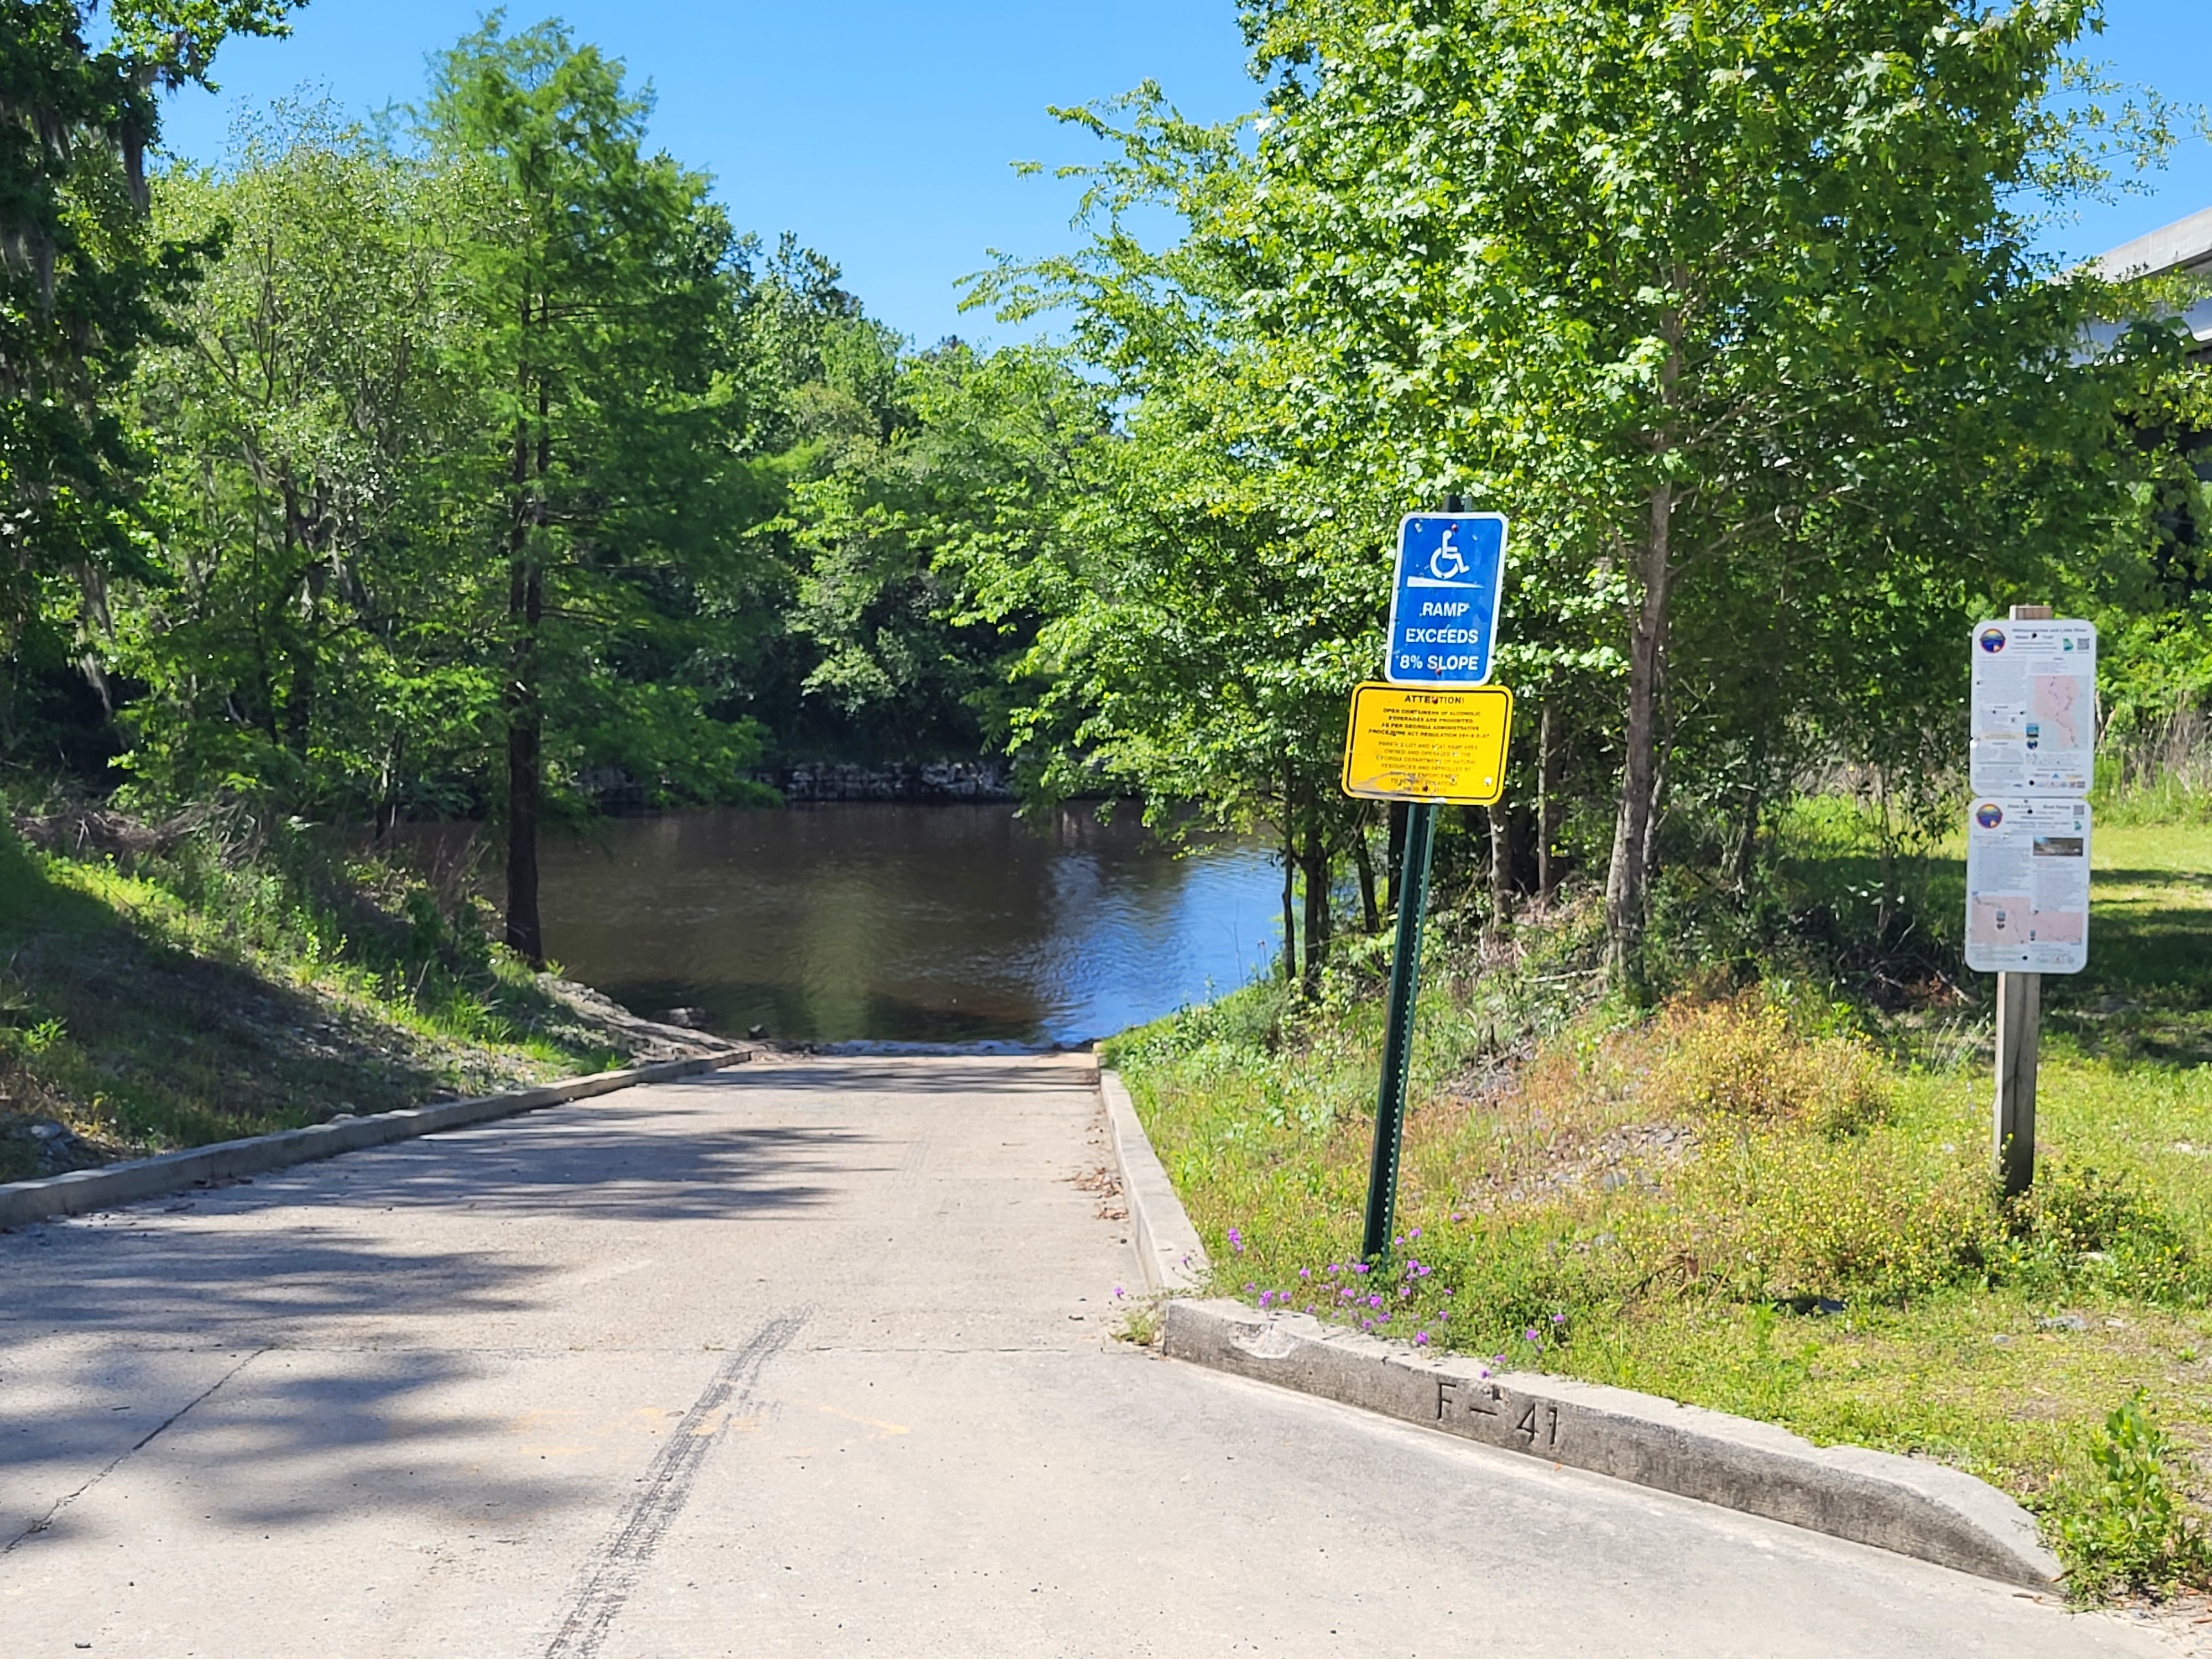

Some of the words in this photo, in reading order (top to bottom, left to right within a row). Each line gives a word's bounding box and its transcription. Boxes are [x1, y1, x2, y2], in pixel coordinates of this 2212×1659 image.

[1423, 602, 1469, 617] RAMP
[1406, 628, 1479, 644] EXCEEDS
[1400, 654, 1423, 669] 8%
[1427, 655, 1479, 670] SLOPE
